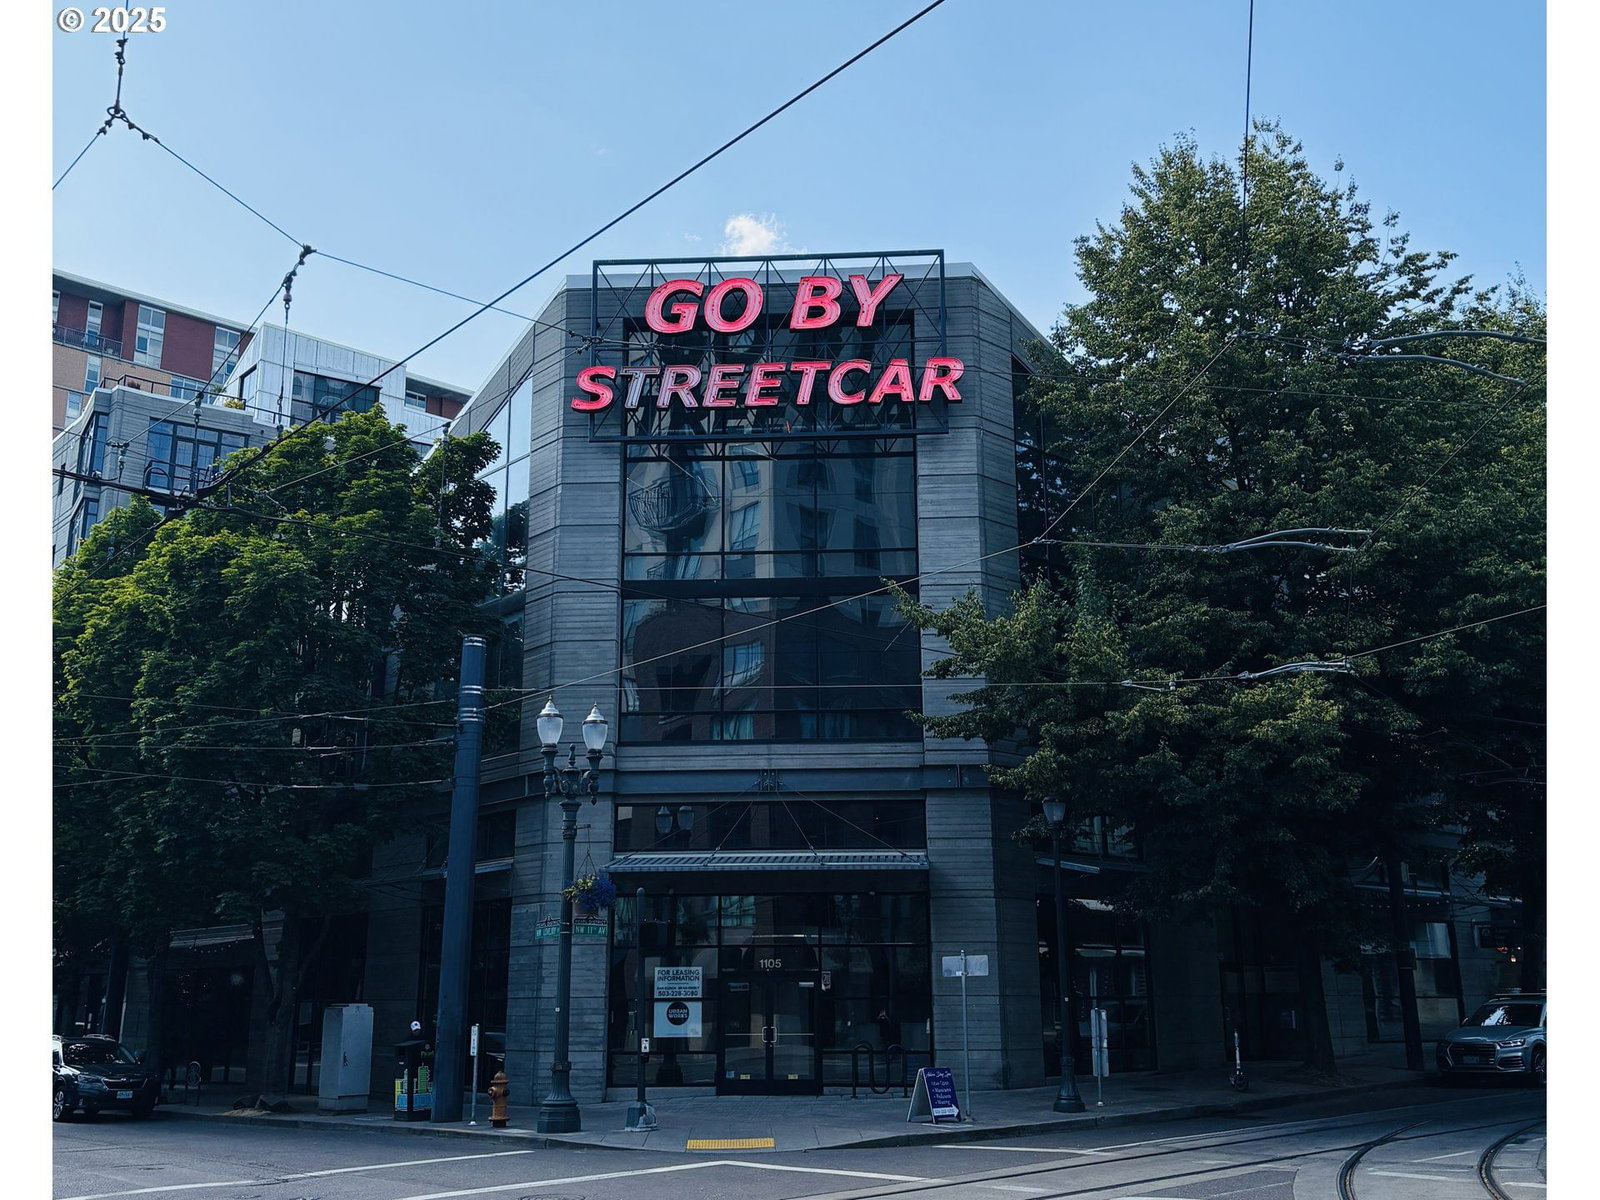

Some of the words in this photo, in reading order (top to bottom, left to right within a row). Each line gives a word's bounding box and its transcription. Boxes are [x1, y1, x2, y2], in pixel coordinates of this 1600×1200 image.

[644, 277, 764, 334] GO
[789, 273, 904, 331] BY
[571, 356, 965, 412] STREETCAR
[575, 925, 584, 934] NW
[759, 959, 782, 969] 1105
